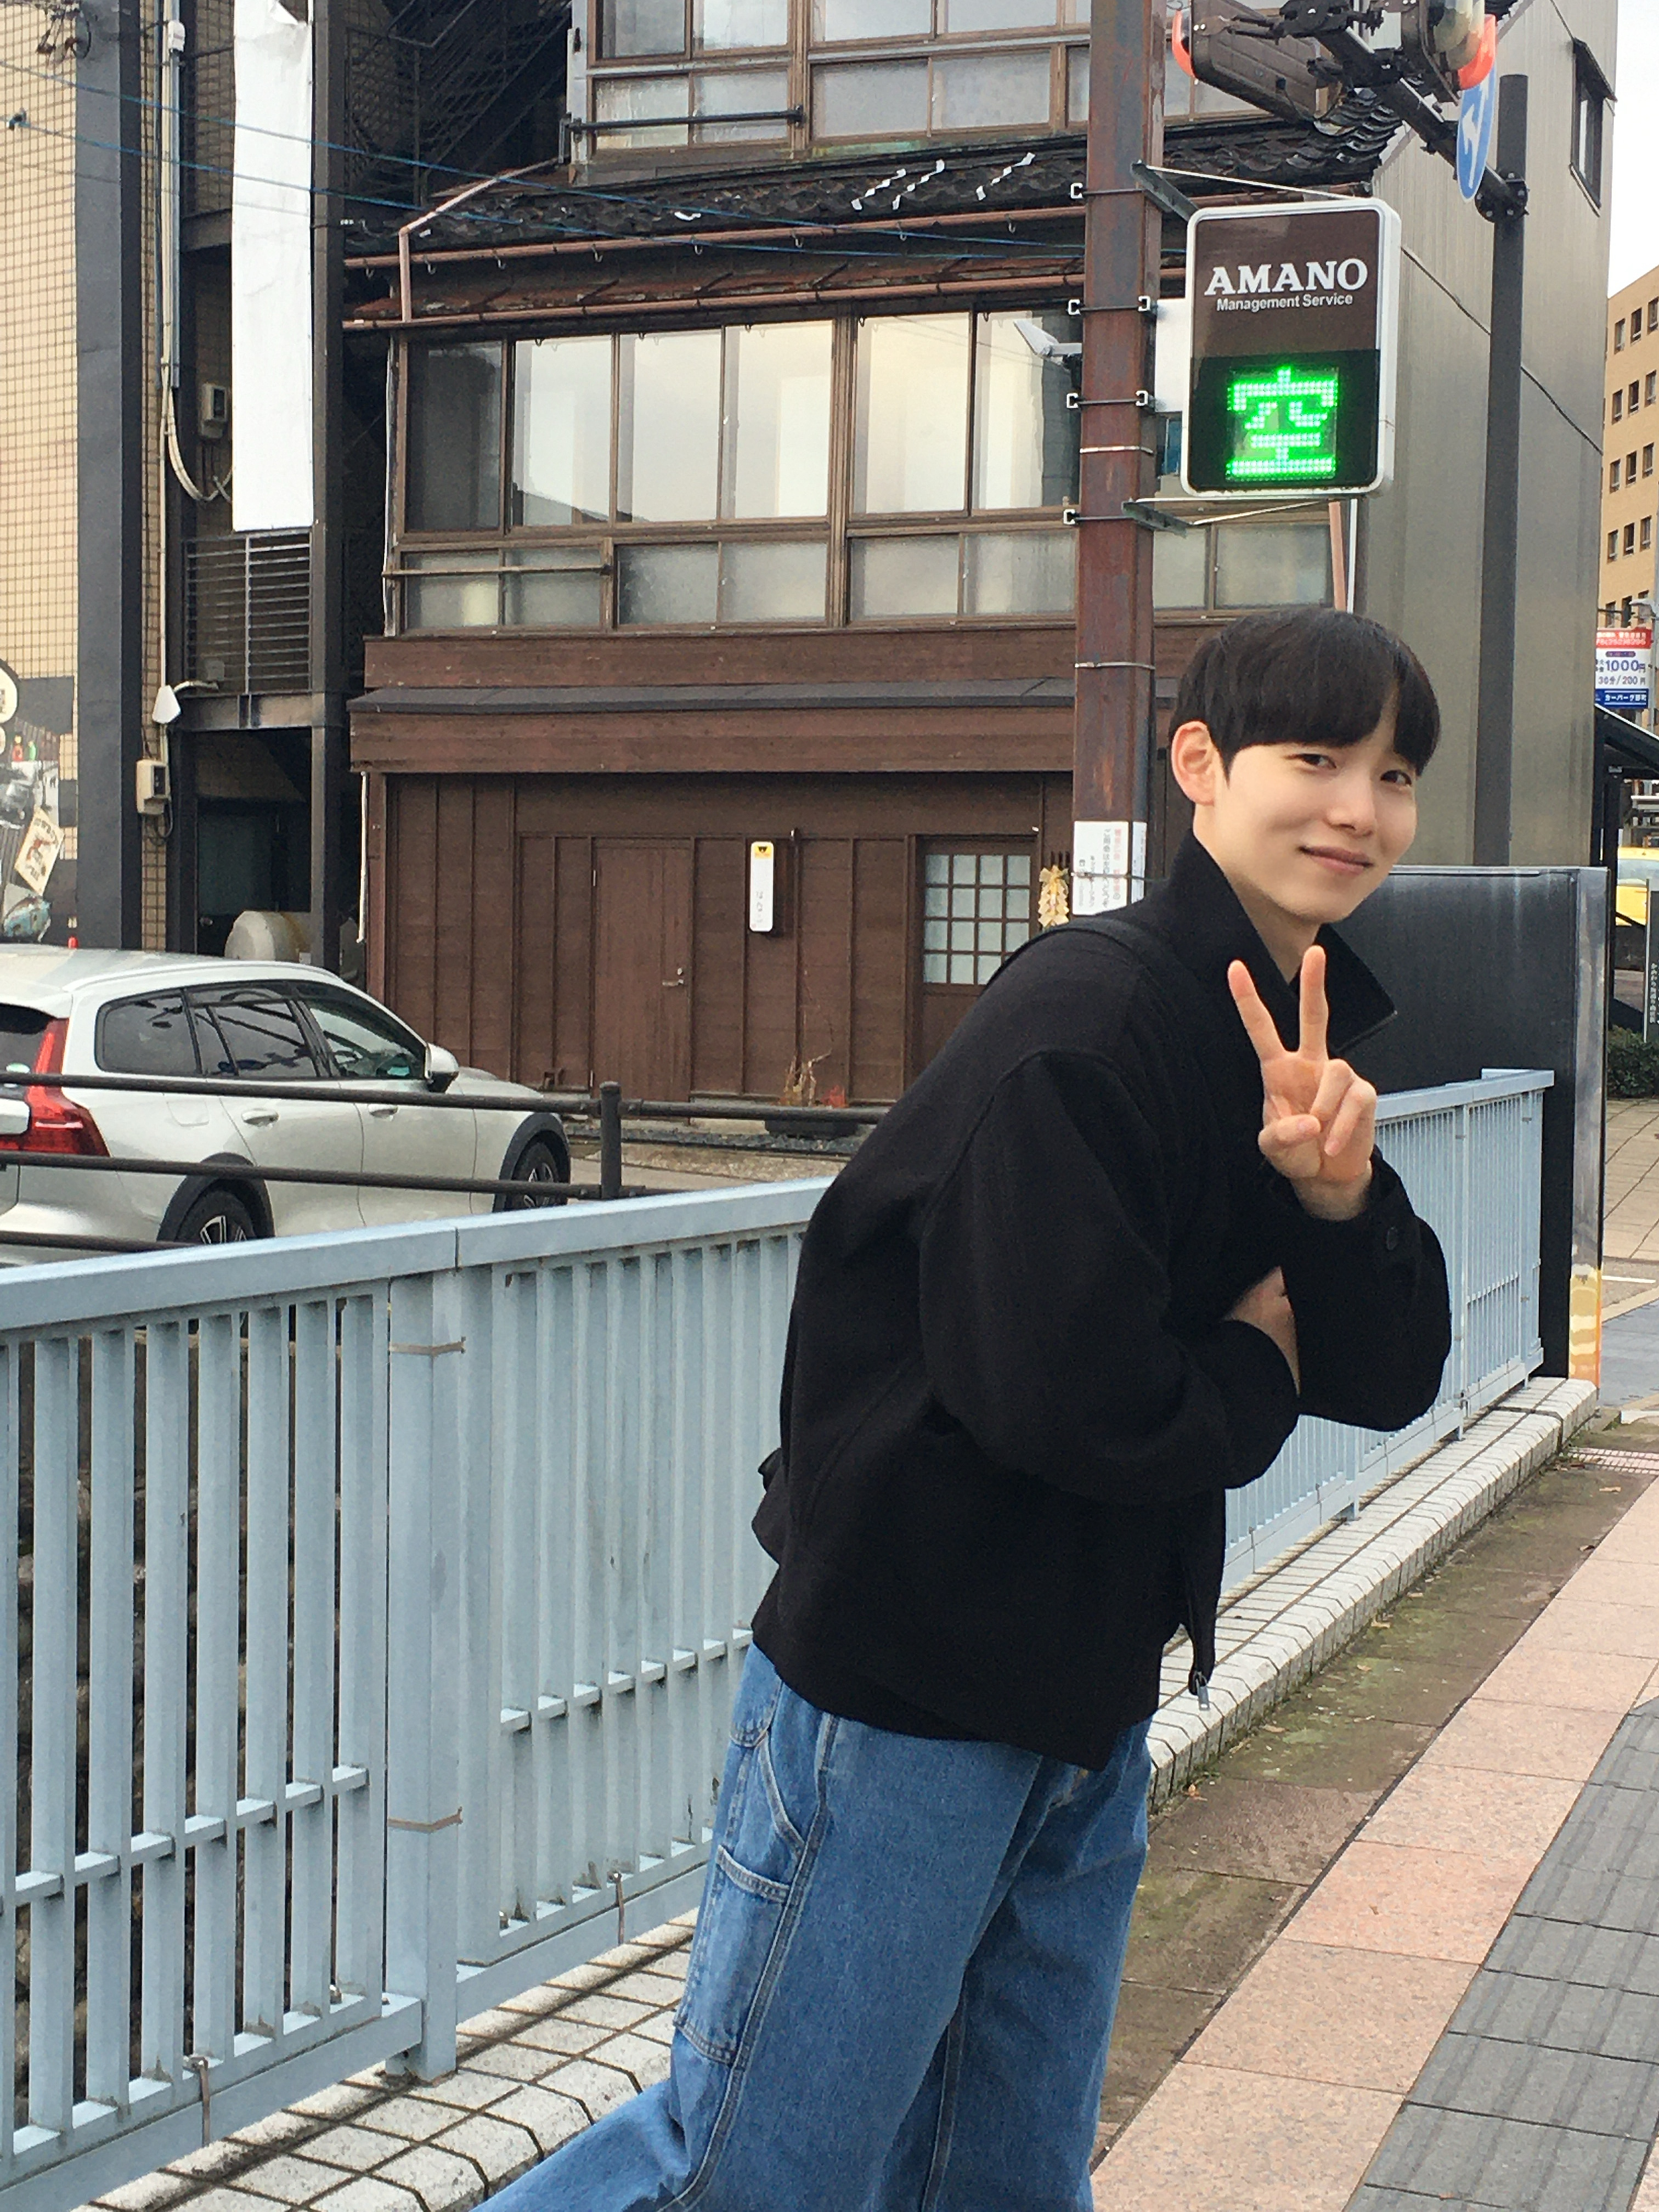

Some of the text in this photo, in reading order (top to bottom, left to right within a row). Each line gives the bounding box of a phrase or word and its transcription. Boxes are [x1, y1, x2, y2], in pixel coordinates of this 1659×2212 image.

[1204, 258, 1368, 296] AMANO
[1216, 292, 1353, 313] Management Service
[1228, 369, 1338, 474] 空
